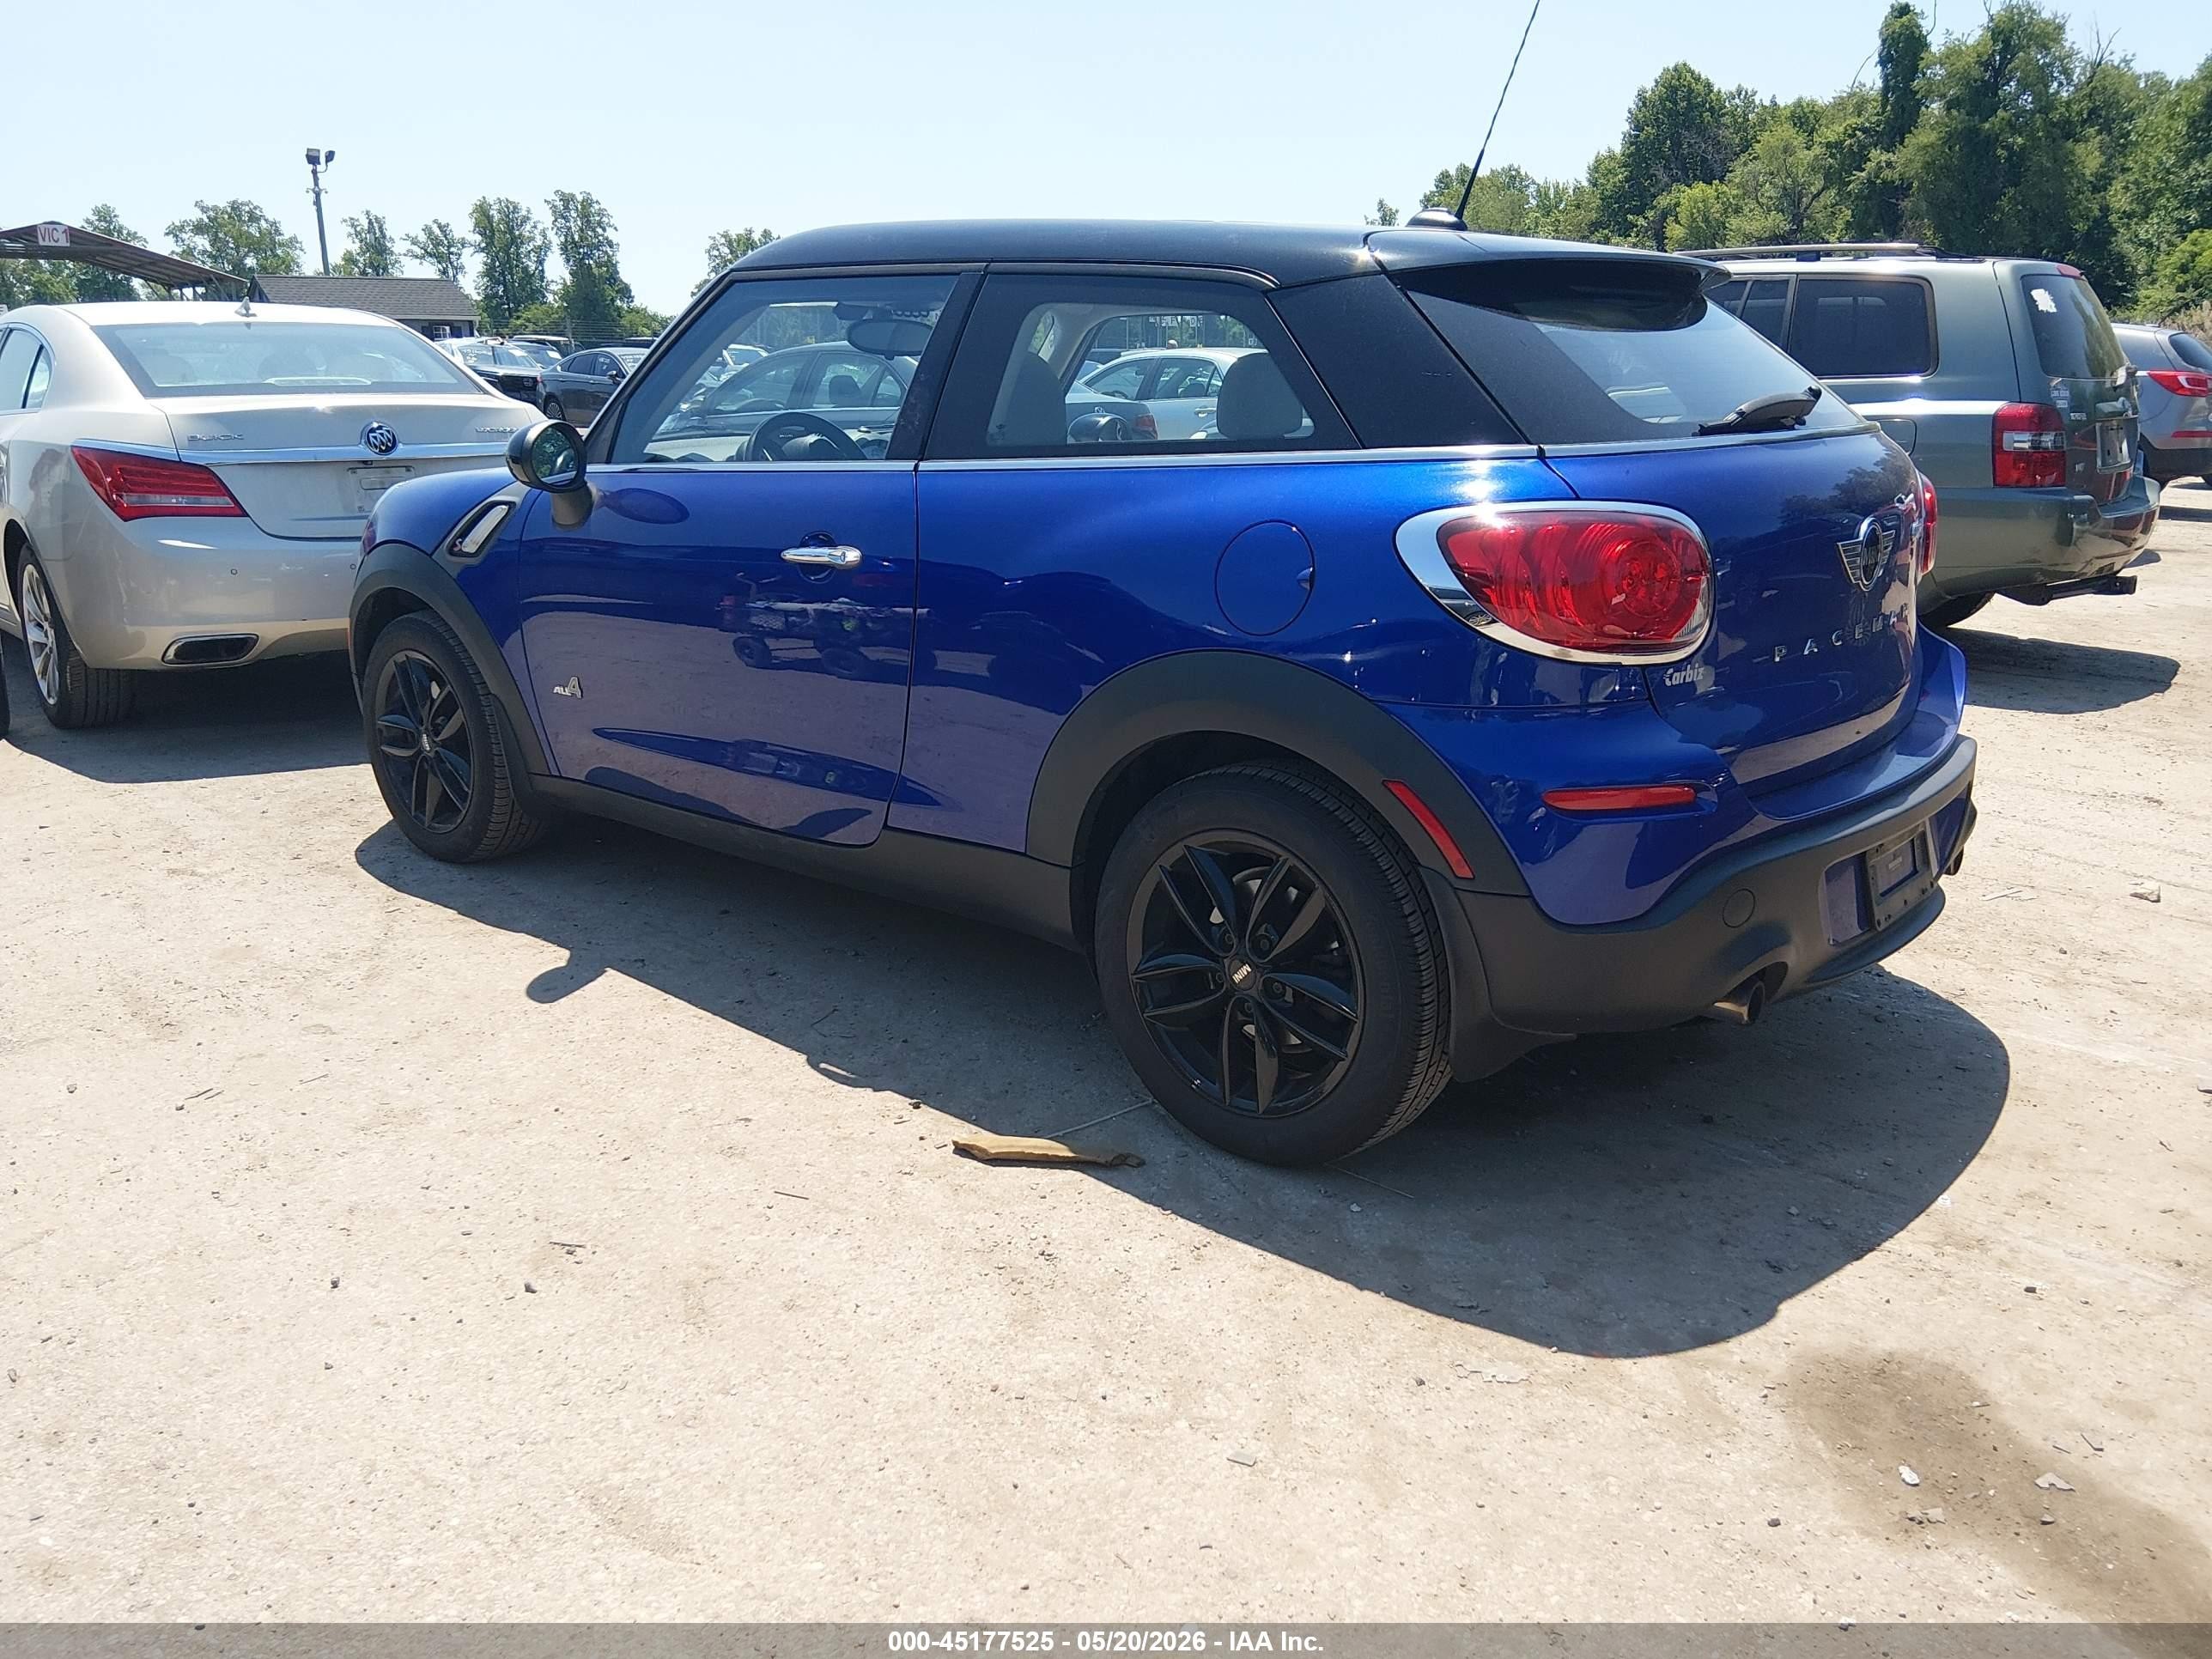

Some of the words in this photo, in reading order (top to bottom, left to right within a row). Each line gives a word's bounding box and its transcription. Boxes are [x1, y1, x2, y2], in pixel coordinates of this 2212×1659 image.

[39, 226, 59, 243] VIC
[61, 228, 70, 243] 1
[453, 538, 463, 552] S
[1662, 663, 1705, 687] Carbiz
[1231, 963, 1252, 984] MINI
